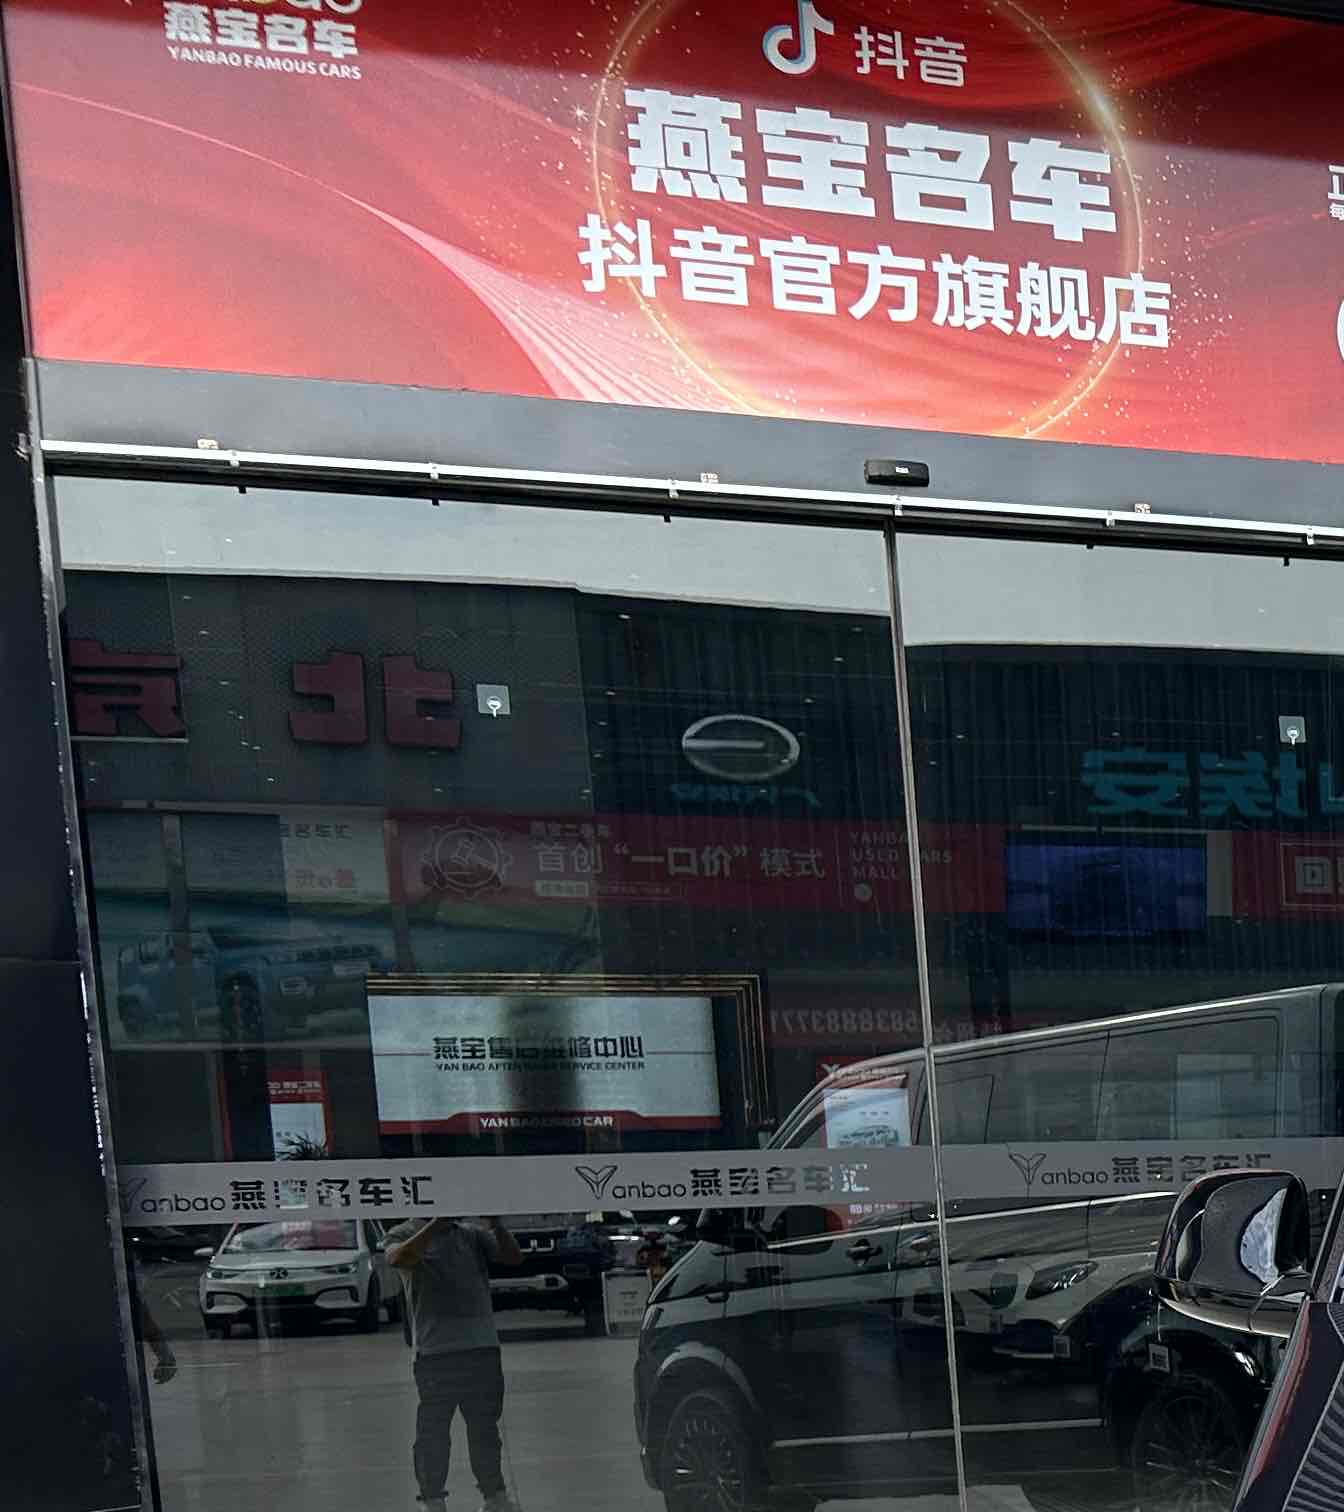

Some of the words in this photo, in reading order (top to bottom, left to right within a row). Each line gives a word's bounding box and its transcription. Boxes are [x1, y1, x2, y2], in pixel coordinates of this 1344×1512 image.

[164, 2, 359, 58] 燕宝名车
[167, 46, 241, 67] YANBAO
[244, 56, 317, 75] FAMOUS
[319, 61, 362, 80] CARS
[851, 26, 967, 88] 抖音
[625, 87, 1117, 242] 燕宝名车
[577, 213, 1172, 348] 抖音官方旗舰店
[605, 1062, 645, 1073] CENTER
[480, 1116, 509, 1128] YAN
[583, 1115, 614, 1128] CAR
[689, 1162, 871, 1197] 燕宝名车汇
